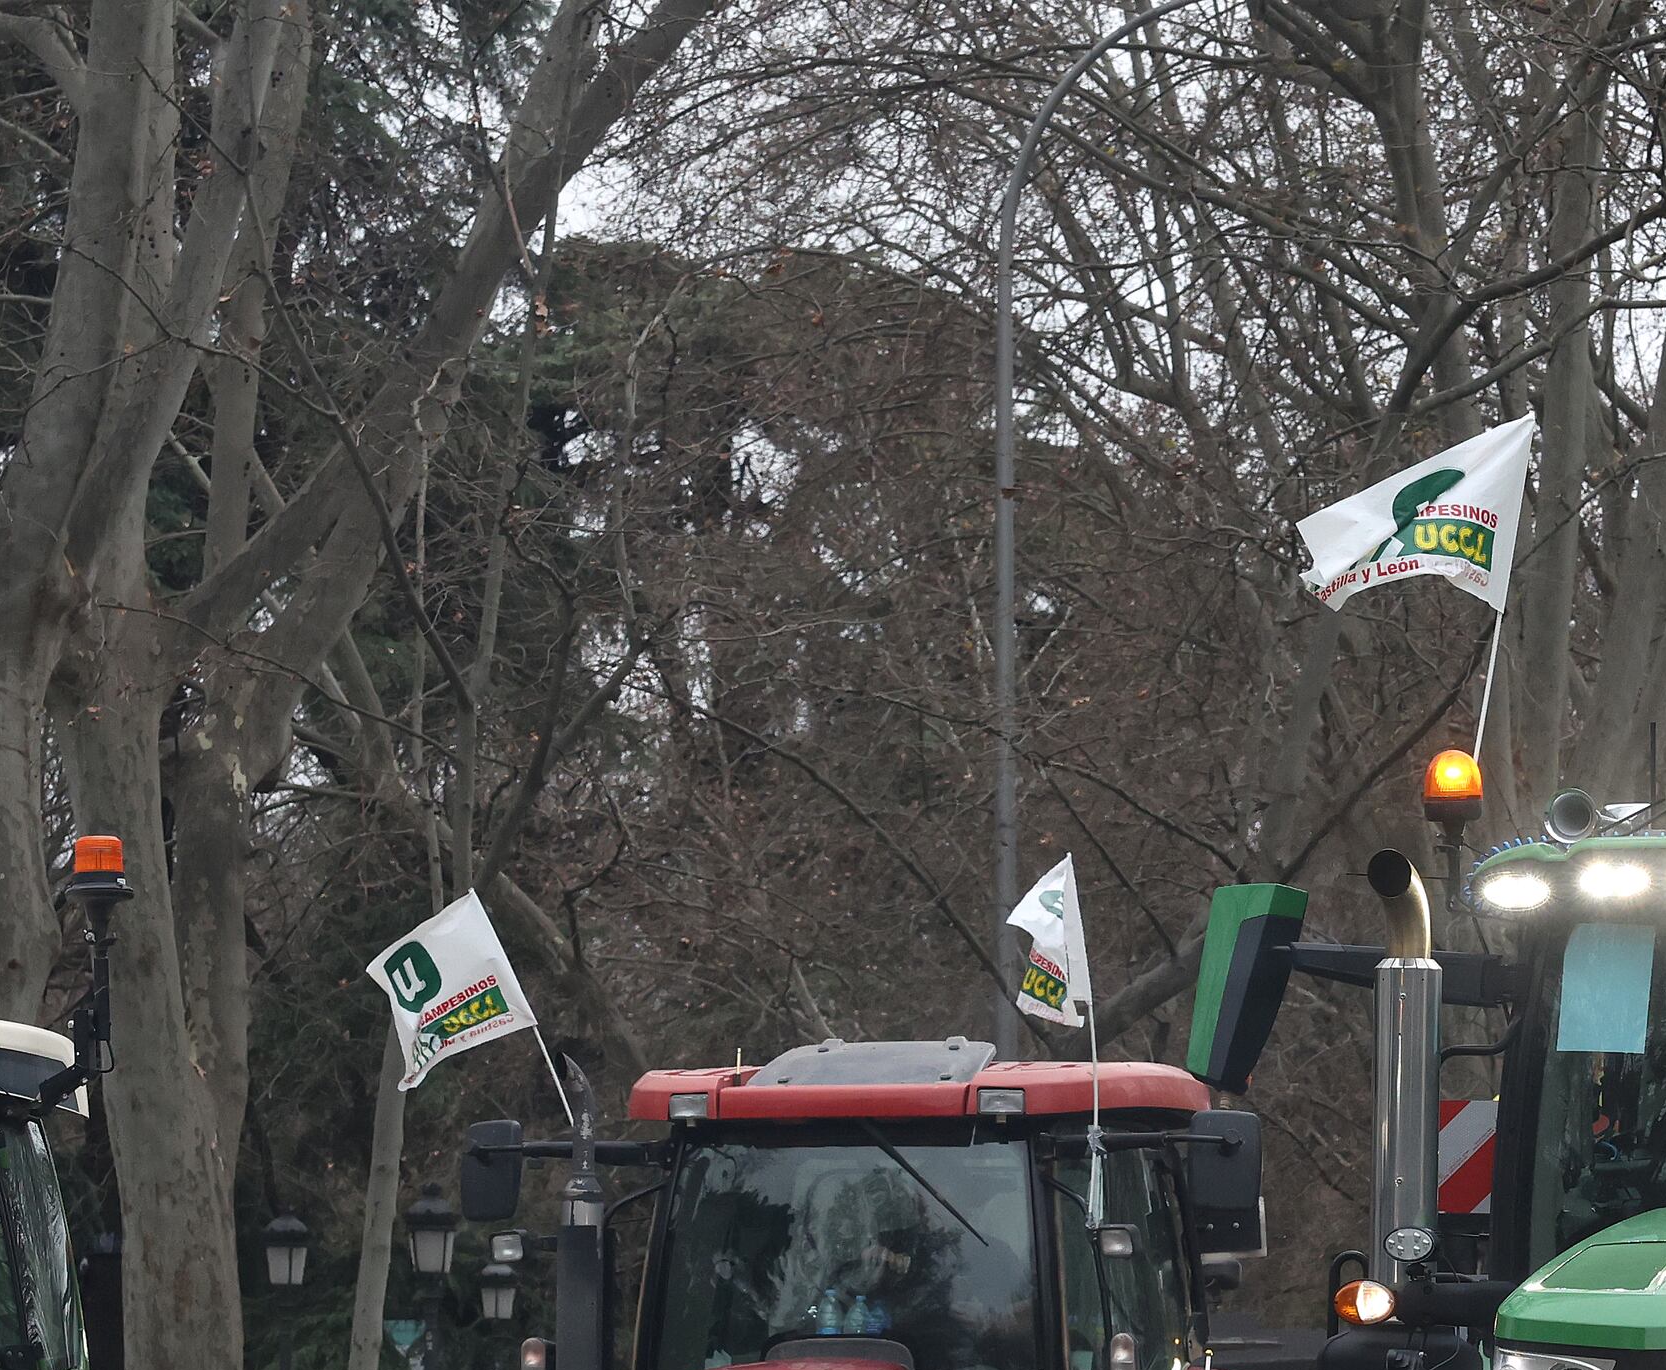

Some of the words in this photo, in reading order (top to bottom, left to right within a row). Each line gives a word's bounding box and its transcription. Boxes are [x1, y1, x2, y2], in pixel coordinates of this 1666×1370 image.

[1413, 522, 1486, 563] UCCL
[1362, 566, 1371, 583] y
[1377, 558, 1420, 577] León
